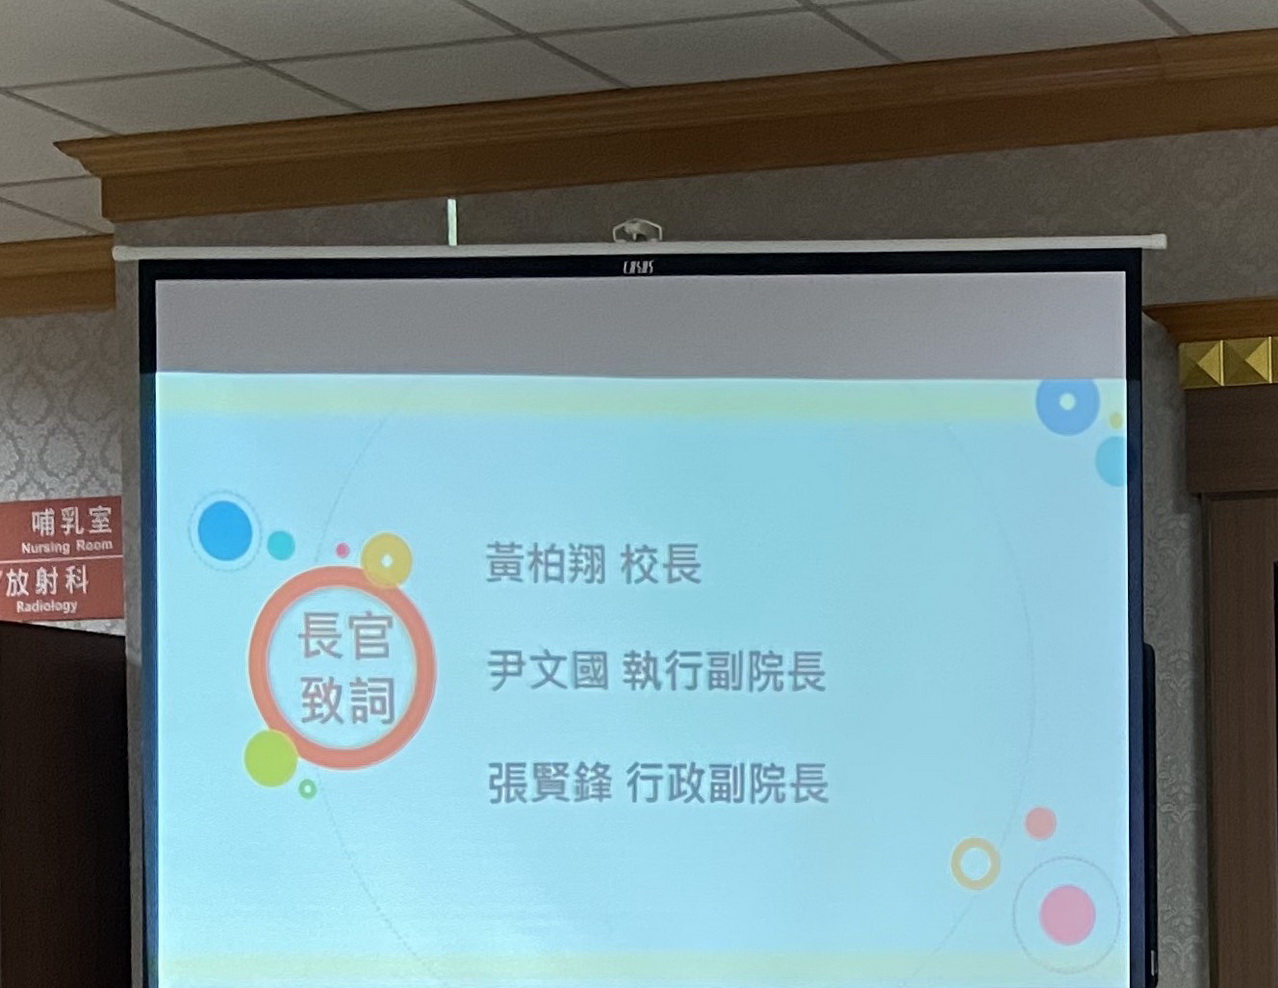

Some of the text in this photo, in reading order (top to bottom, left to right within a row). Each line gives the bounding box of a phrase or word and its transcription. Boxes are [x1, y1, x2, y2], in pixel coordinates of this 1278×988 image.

[31, 505, 112, 537] 哺乳室
[21, 540, 113, 555] Nursing Room
[486, 542, 702, 585] 黃柏翔 校長
[0, 564, 88, 597] 放射科
[16, 600, 78, 614] Radiology
[298, 611, 394, 661] 長官
[487, 649, 827, 693] 尹文國 執行副院長
[299, 675, 396, 725] 致詞
[488, 761, 829, 805] 張賢鋒 行政副院長
